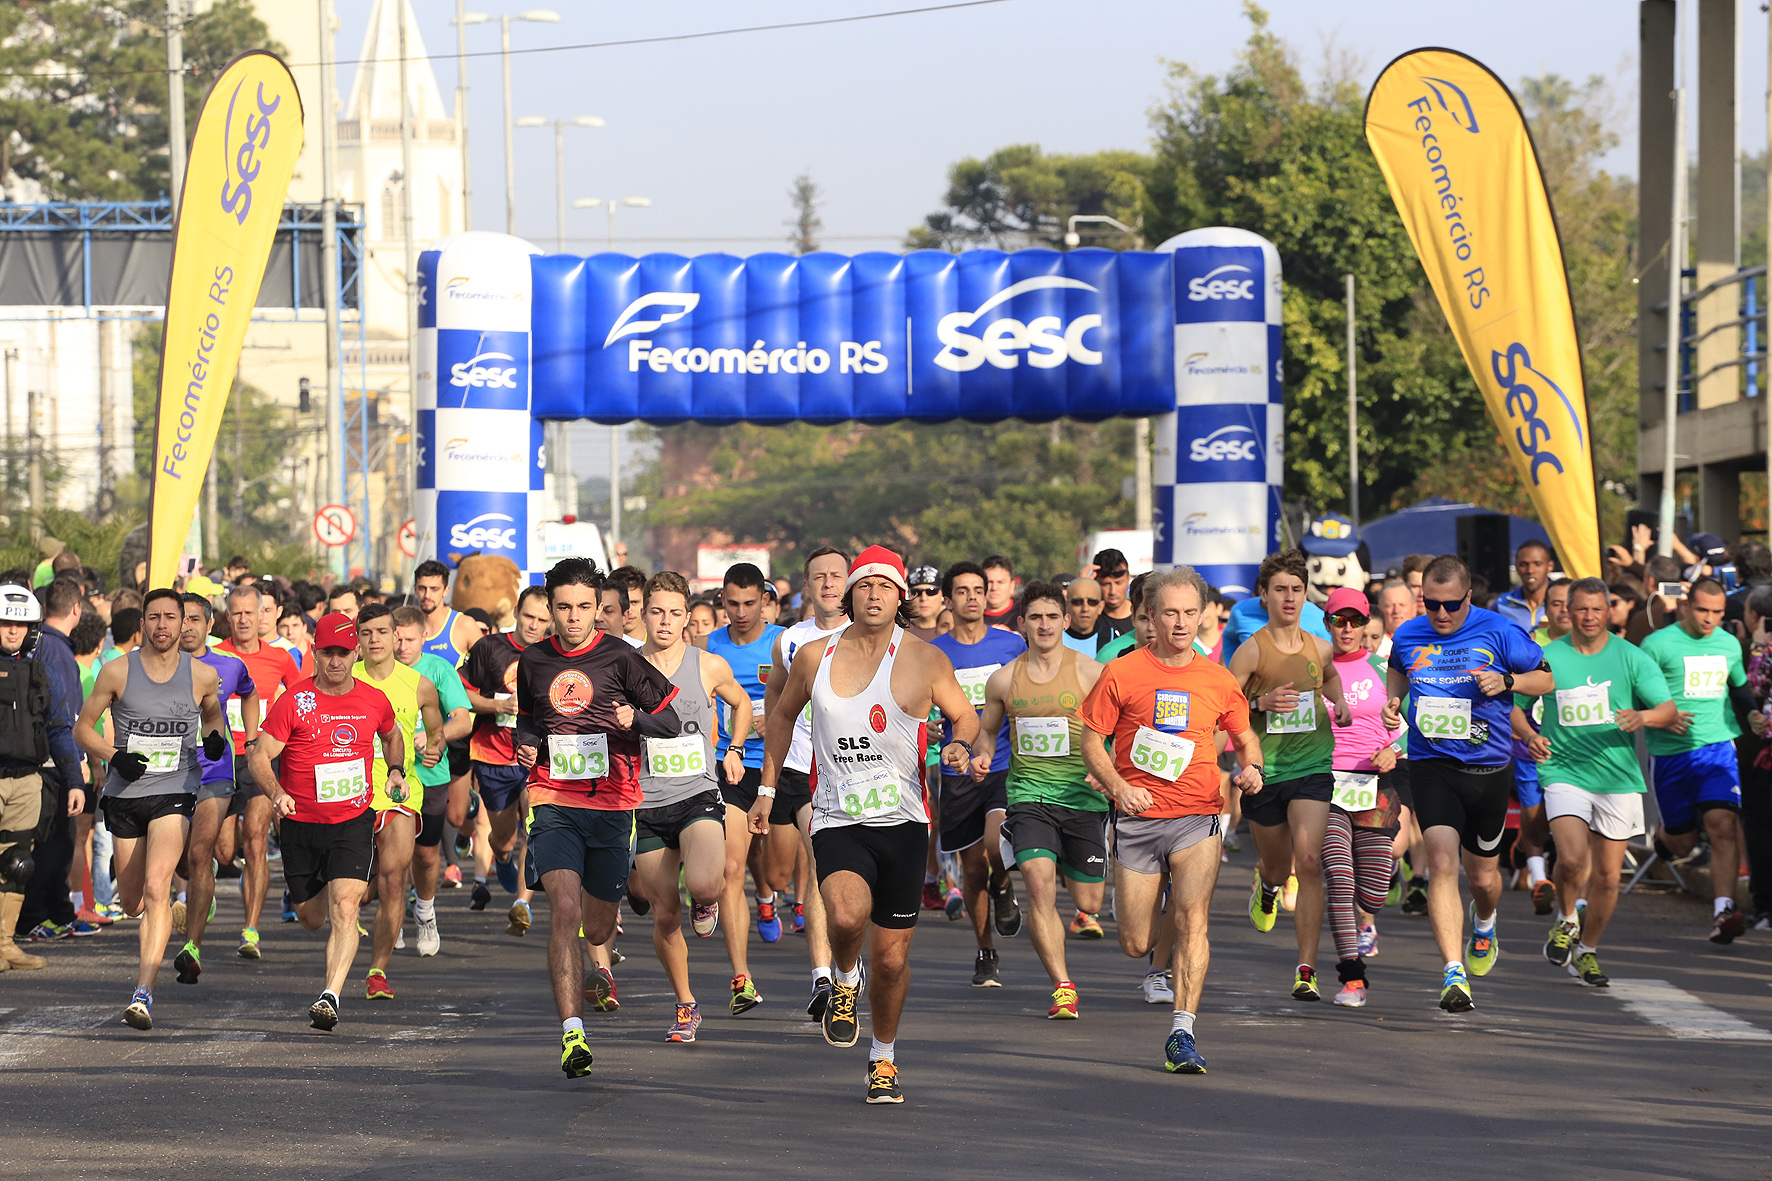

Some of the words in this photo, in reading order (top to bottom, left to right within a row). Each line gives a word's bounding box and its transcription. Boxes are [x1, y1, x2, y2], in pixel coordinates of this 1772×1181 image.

[221, 73, 281, 226] Sesc
[1407, 95, 1473, 261] Fecomércio
[1463, 267, 1490, 310] RS
[1188, 264, 1255, 302] Sesc
[933, 275, 1103, 372] Sesc
[629, 339, 831, 375] Fecomércio
[839, 340, 889, 375] RS
[162, 312, 220, 480] Fecomércio
[209, 265, 234, 305] RS
[449, 351, 517, 389] Sesc
[1491, 341, 1583, 486] Sesc
[1189, 424, 1256, 462] Sesc
[449, 512, 517, 550] Sesc
[1443, 648, 1470, 656] EQUIPE
[1438, 675, 1473, 685] SOMOS
[1688, 670, 1726, 687] 872
[1270, 708, 1314, 730] 644
[1419, 713, 1468, 735] 629
[1561, 702, 1605, 723] 601
[127, 717, 189, 734] PÓDIO
[837, 736, 871, 751] SLS
[1020, 733, 1066, 753] 637
[553, 752, 606, 775] 903
[652, 751, 703, 773] 896
[833, 754, 854, 764] Free
[856, 753, 883, 763] Race
[1133, 743, 1185, 778] 591
[321, 774, 364, 799] 585
[844, 784, 901, 816] 843
